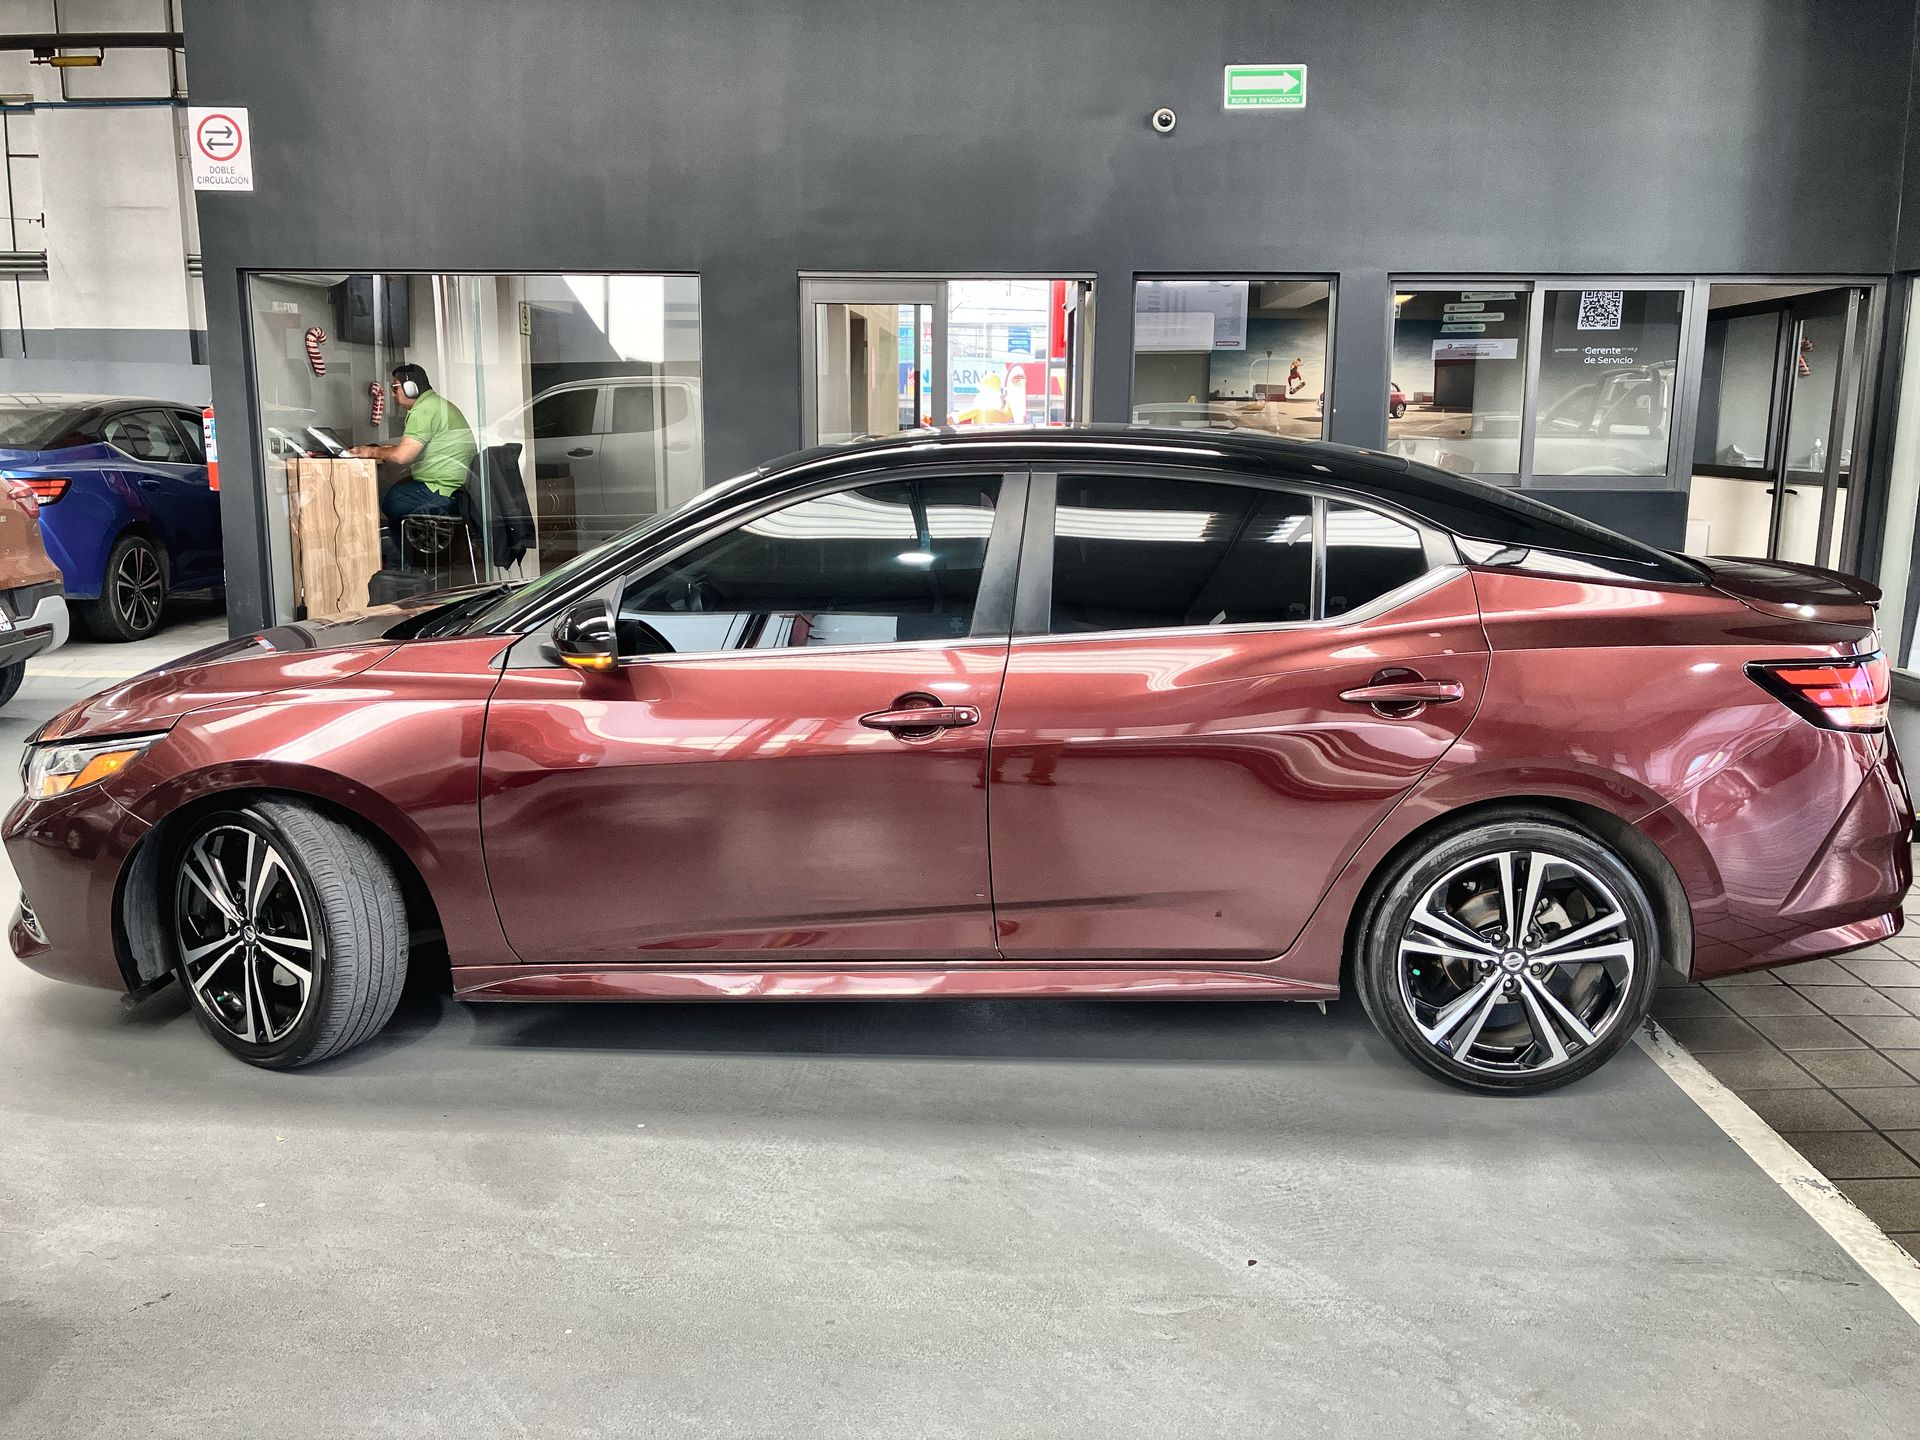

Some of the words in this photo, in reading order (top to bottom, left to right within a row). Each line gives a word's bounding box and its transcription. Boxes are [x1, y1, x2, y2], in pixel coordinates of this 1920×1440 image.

[209, 166, 235, 174] DOBLE
[1584, 346, 1621, 355] Gerente
[1583, 356, 1596, 364] de
[1597, 356, 1634, 364] Servicio
